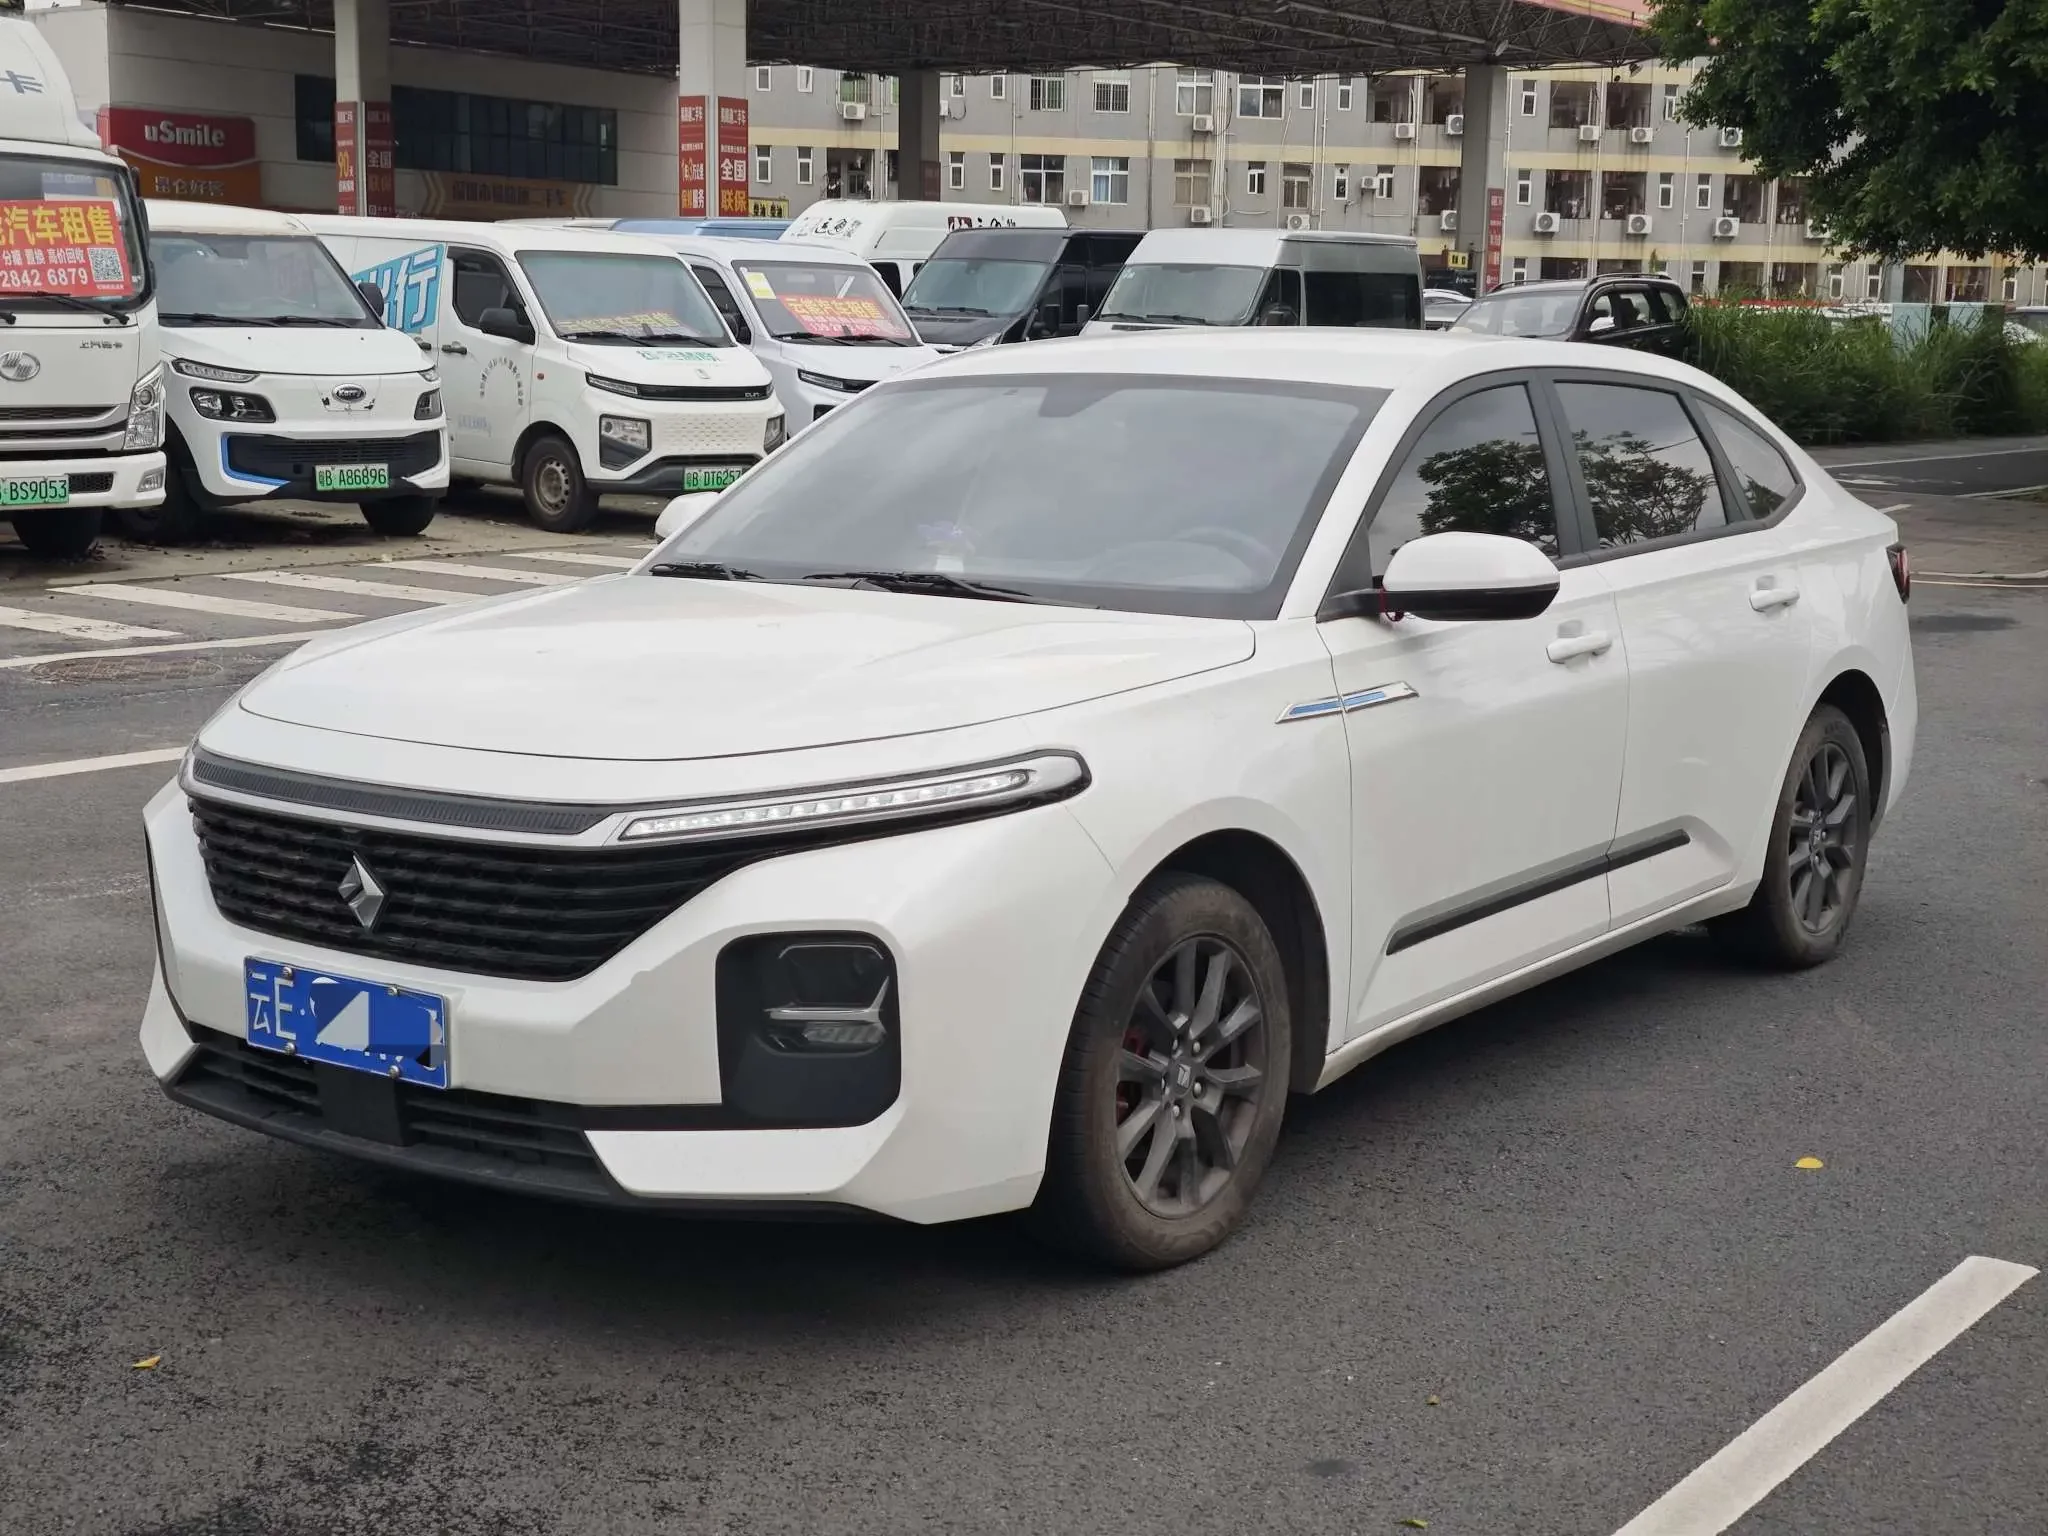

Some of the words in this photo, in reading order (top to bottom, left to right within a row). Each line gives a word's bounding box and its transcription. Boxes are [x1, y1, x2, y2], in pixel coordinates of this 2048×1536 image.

[144, 120, 226, 147] uSmile
[720, 158, 747, 182] 全国
[720, 189, 748, 212] 联保
[0, 205, 115, 246] 汽车租售
[47, 246, 86, 265] 高价回收
[0, 269, 42, 288] 2842
[47, 267, 88, 286] 6879
[10, 479, 67, 501] BS9053
